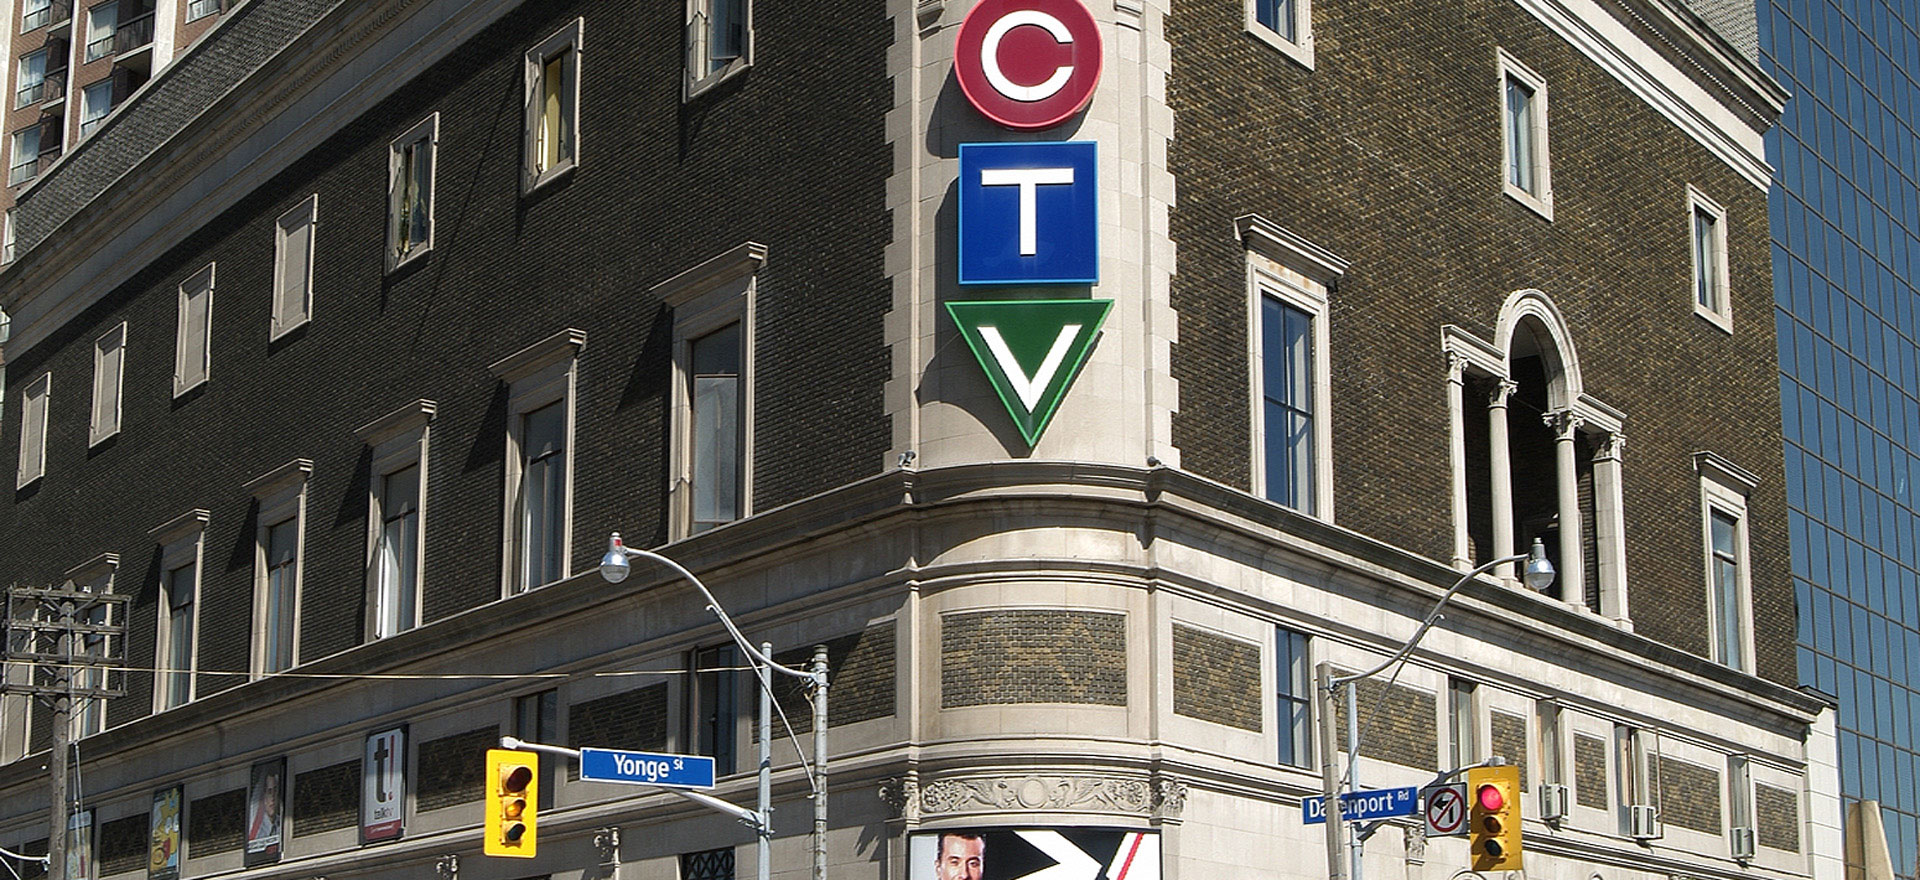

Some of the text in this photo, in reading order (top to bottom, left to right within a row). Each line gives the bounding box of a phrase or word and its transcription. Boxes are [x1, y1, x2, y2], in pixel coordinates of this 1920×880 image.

[613, 754, 684, 782] Yonge St
[1309, 790, 1410, 818] Daenport Rd
